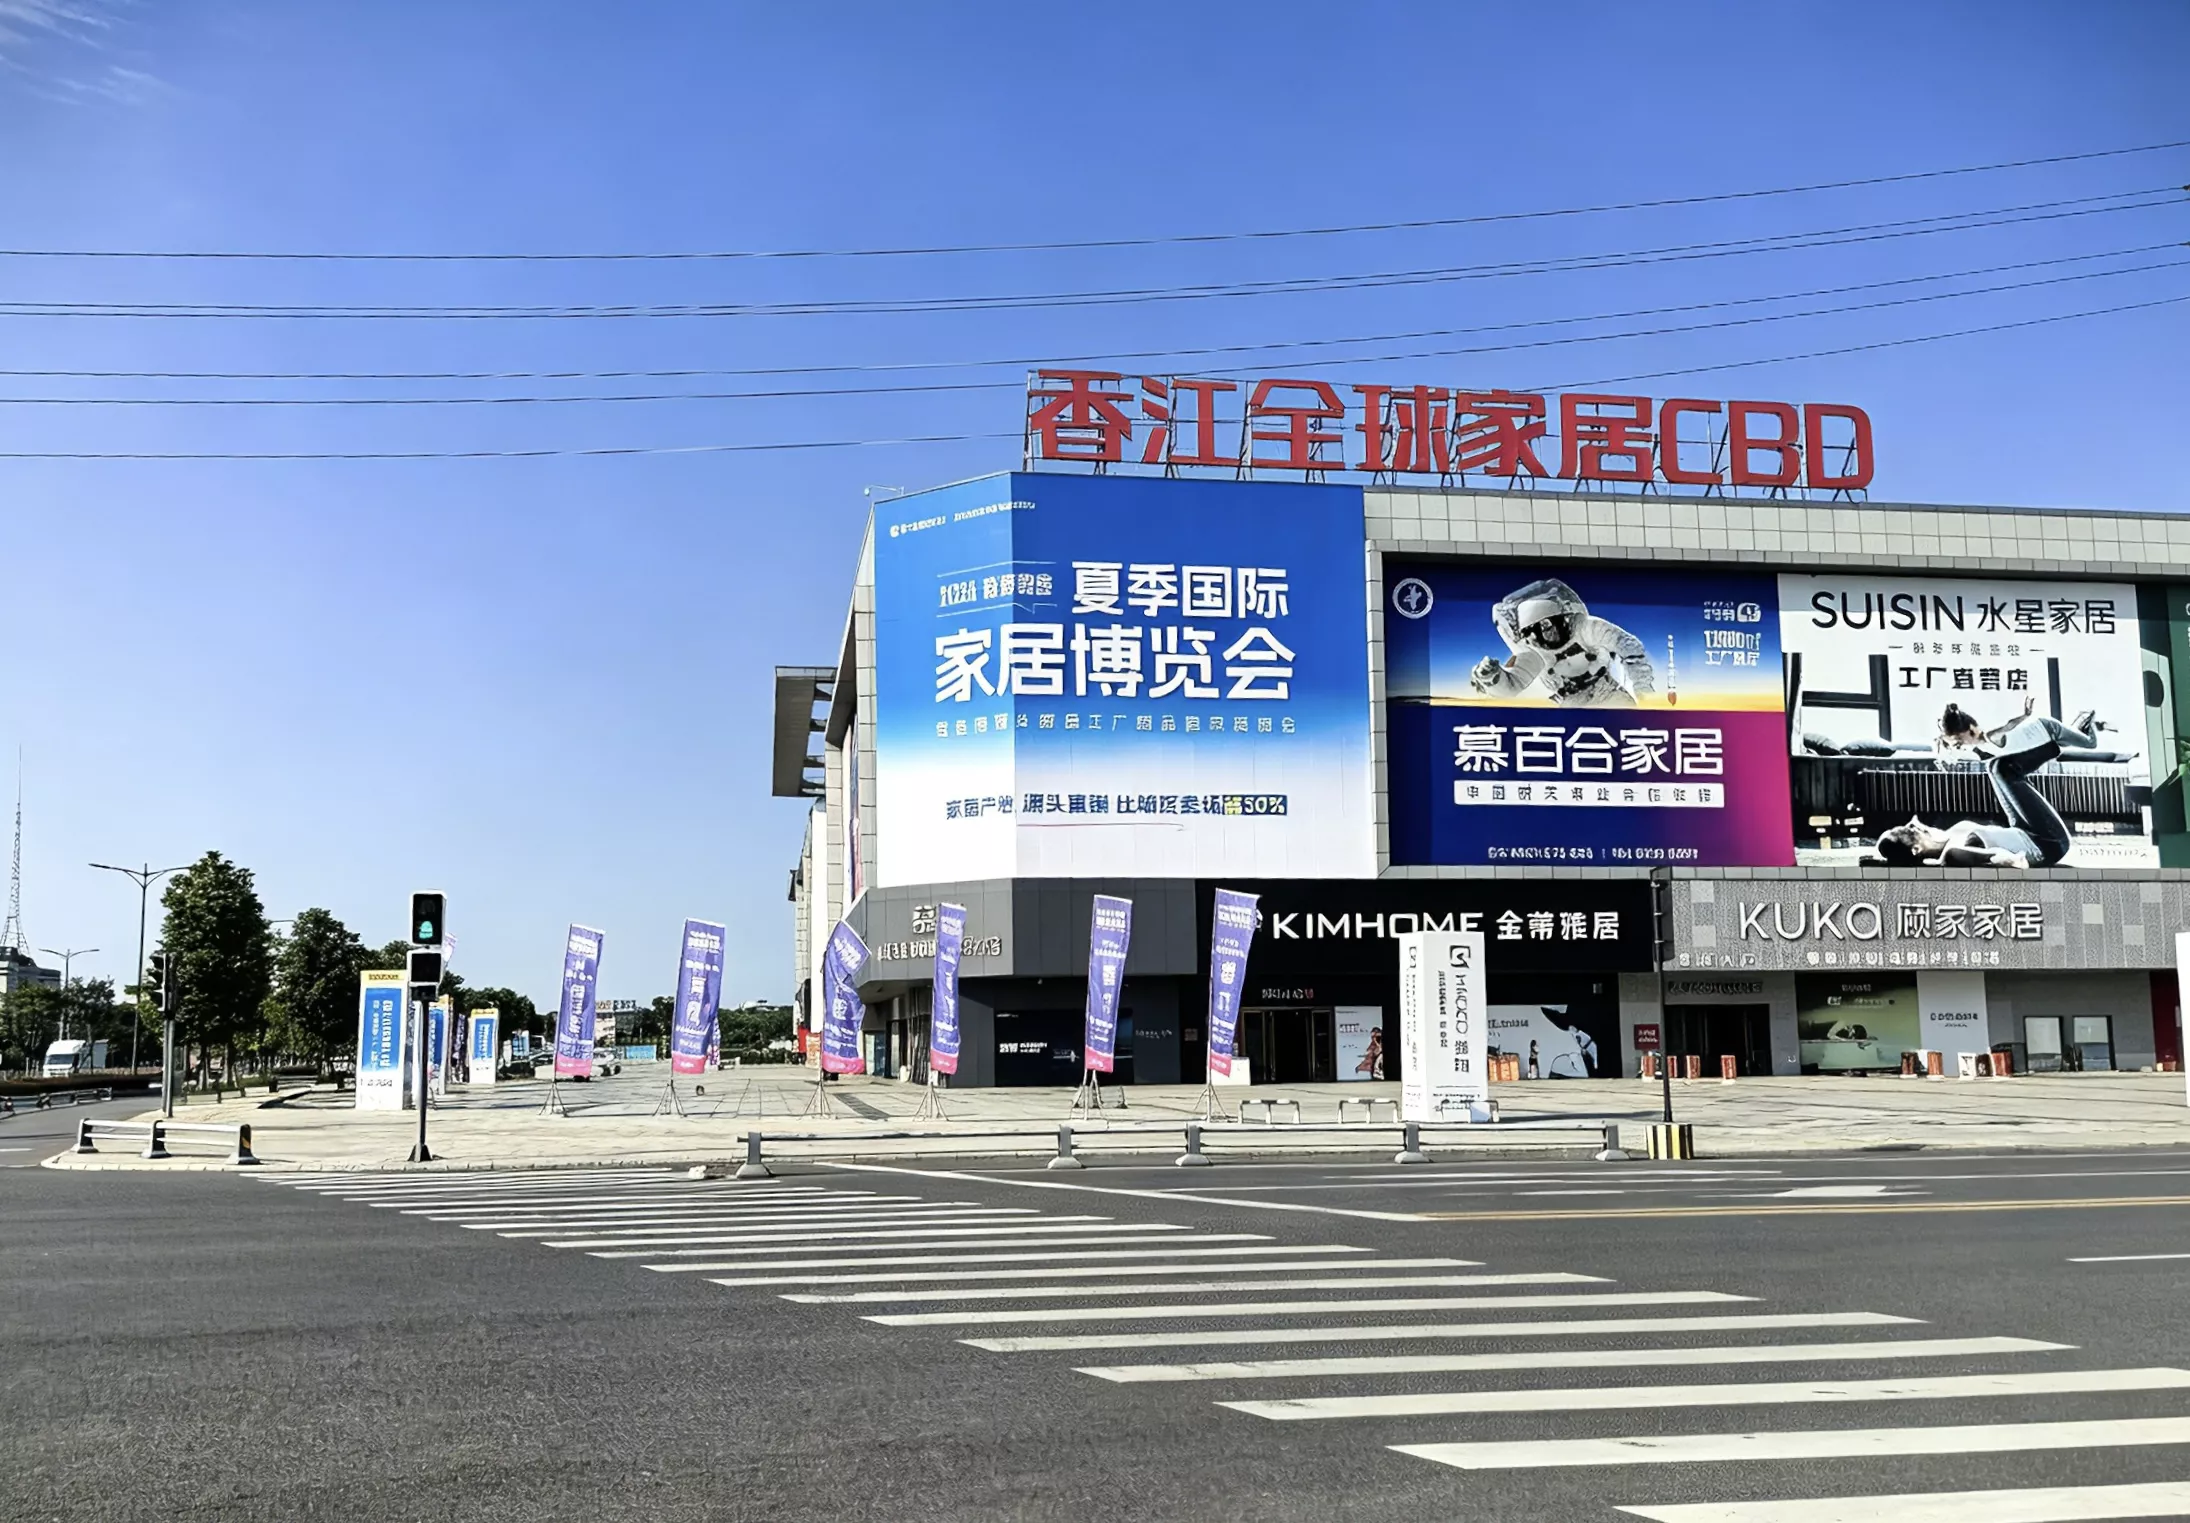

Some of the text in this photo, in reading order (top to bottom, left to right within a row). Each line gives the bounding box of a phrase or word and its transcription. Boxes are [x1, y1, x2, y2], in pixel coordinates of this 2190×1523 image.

[1028, 369, 1875, 491] 香江全球家居CBD
[1071, 561, 1290, 618] 夏季国际
[1811, 591, 2116, 636] SUISIN 水星家居
[935, 622, 1297, 703] 家居博览会
[1898, 667, 2028, 691] 工厂直营店
[1453, 724, 1724, 776] 慕百合家居
[1896, 902, 2045, 940] 顾家家居
